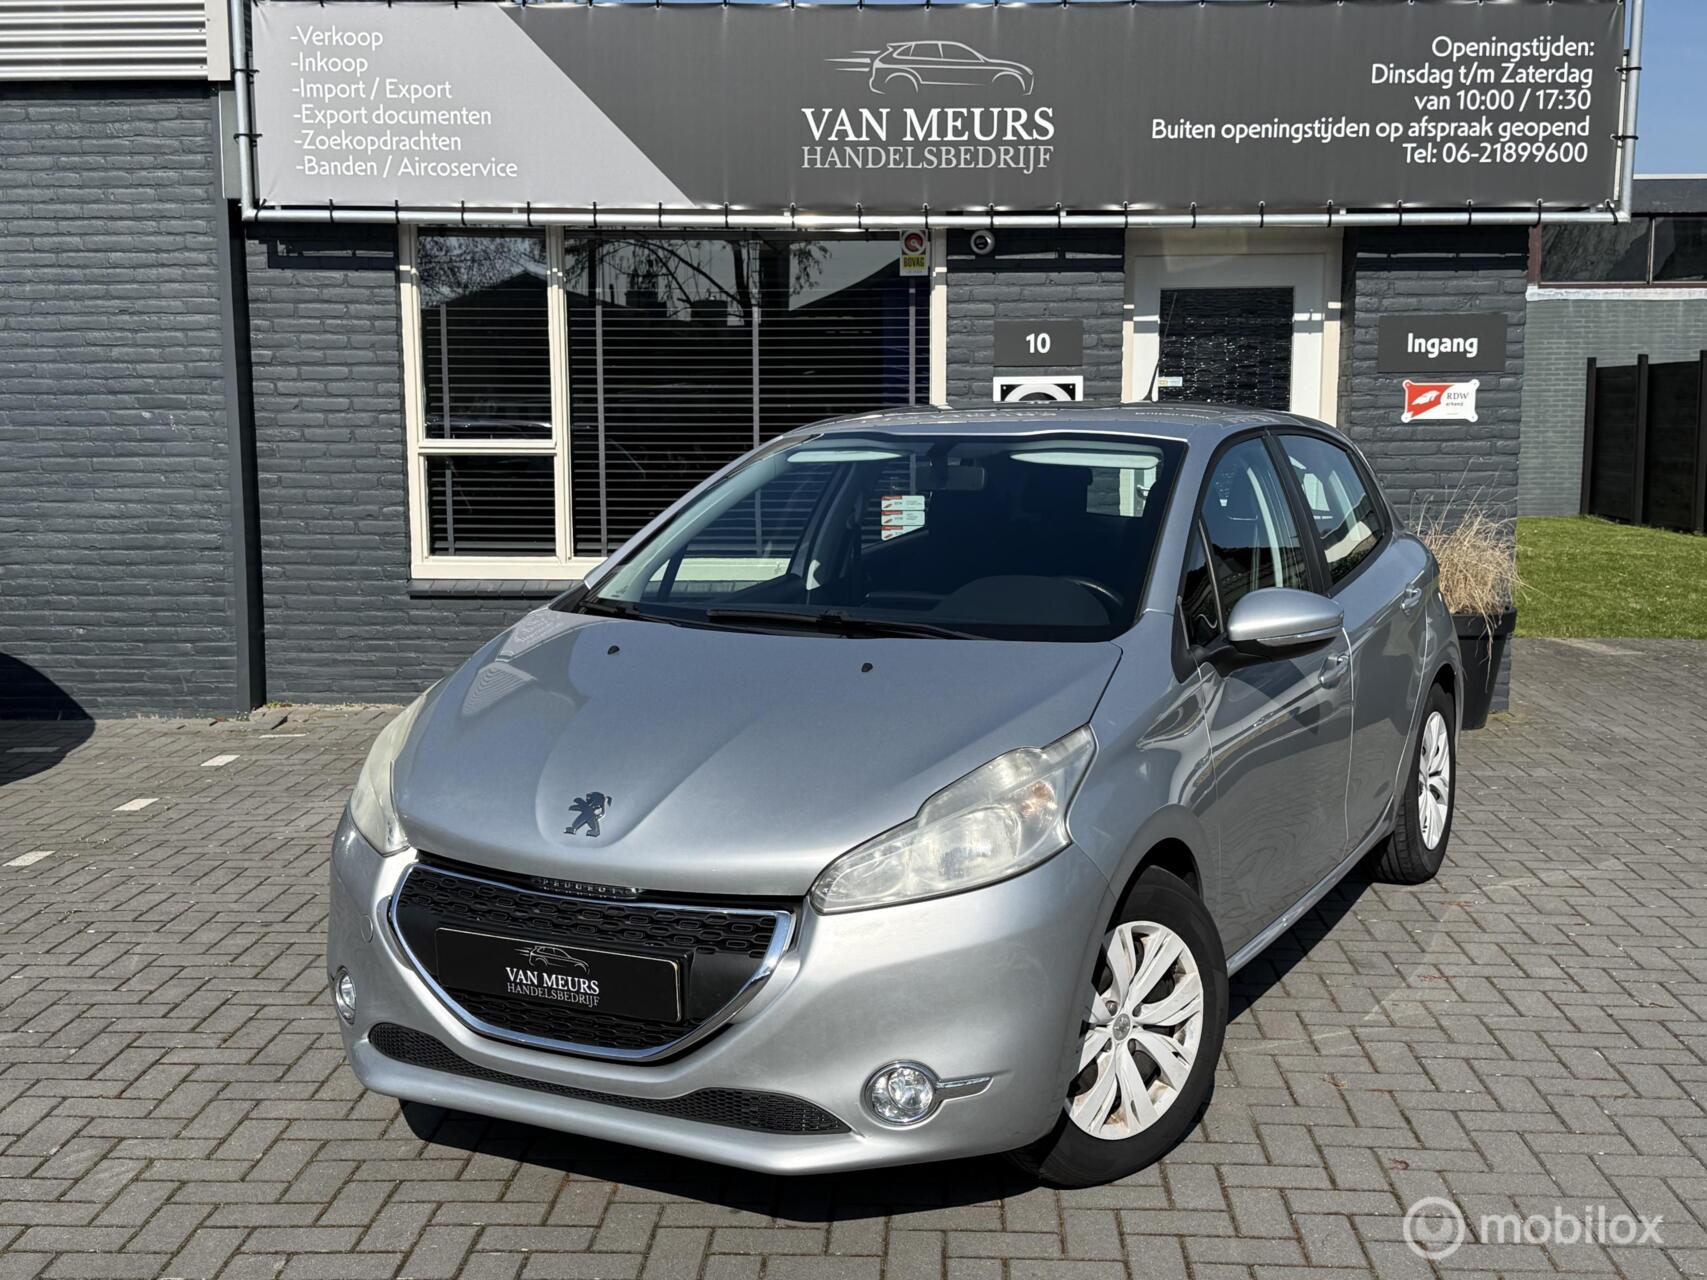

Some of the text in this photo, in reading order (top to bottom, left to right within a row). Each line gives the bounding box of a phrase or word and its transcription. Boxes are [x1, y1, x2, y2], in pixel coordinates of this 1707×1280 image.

[290, 25, 384, 51] -Verkoop
[1432, 36, 1595, 62] Openingstijden:
[291, 52, 369, 77] -Inkoop
[1372, 62, 1593, 88] Dinsdag t/m Zaterdag
[292, 77, 453, 102] -Import / Export
[1415, 89, 1592, 112] van 10:00 / 17:30
[293, 104, 492, 128] -Export documenten
[801, 107, 1055, 141] VAN MEURS
[294, 130, 462, 153] -Zoekopdrachten
[1152, 116, 1590, 143] Buiten openingstijden op afspraak geopend
[801, 146, 1054, 174] HANDELSBEDRIJF
[1403, 142, 1588, 163] Tel: 06-21899600
[296, 156, 518, 178] -Banden / Aircoservice
[1025, 333, 1051, 353] 10
[1407, 332, 1478, 359] Ingang
[1446, 392, 1468, 400] RDW
[505, 967, 600, 995] VAN MEURS
[507, 982, 600, 1008] HANDELSBEDRIJF
